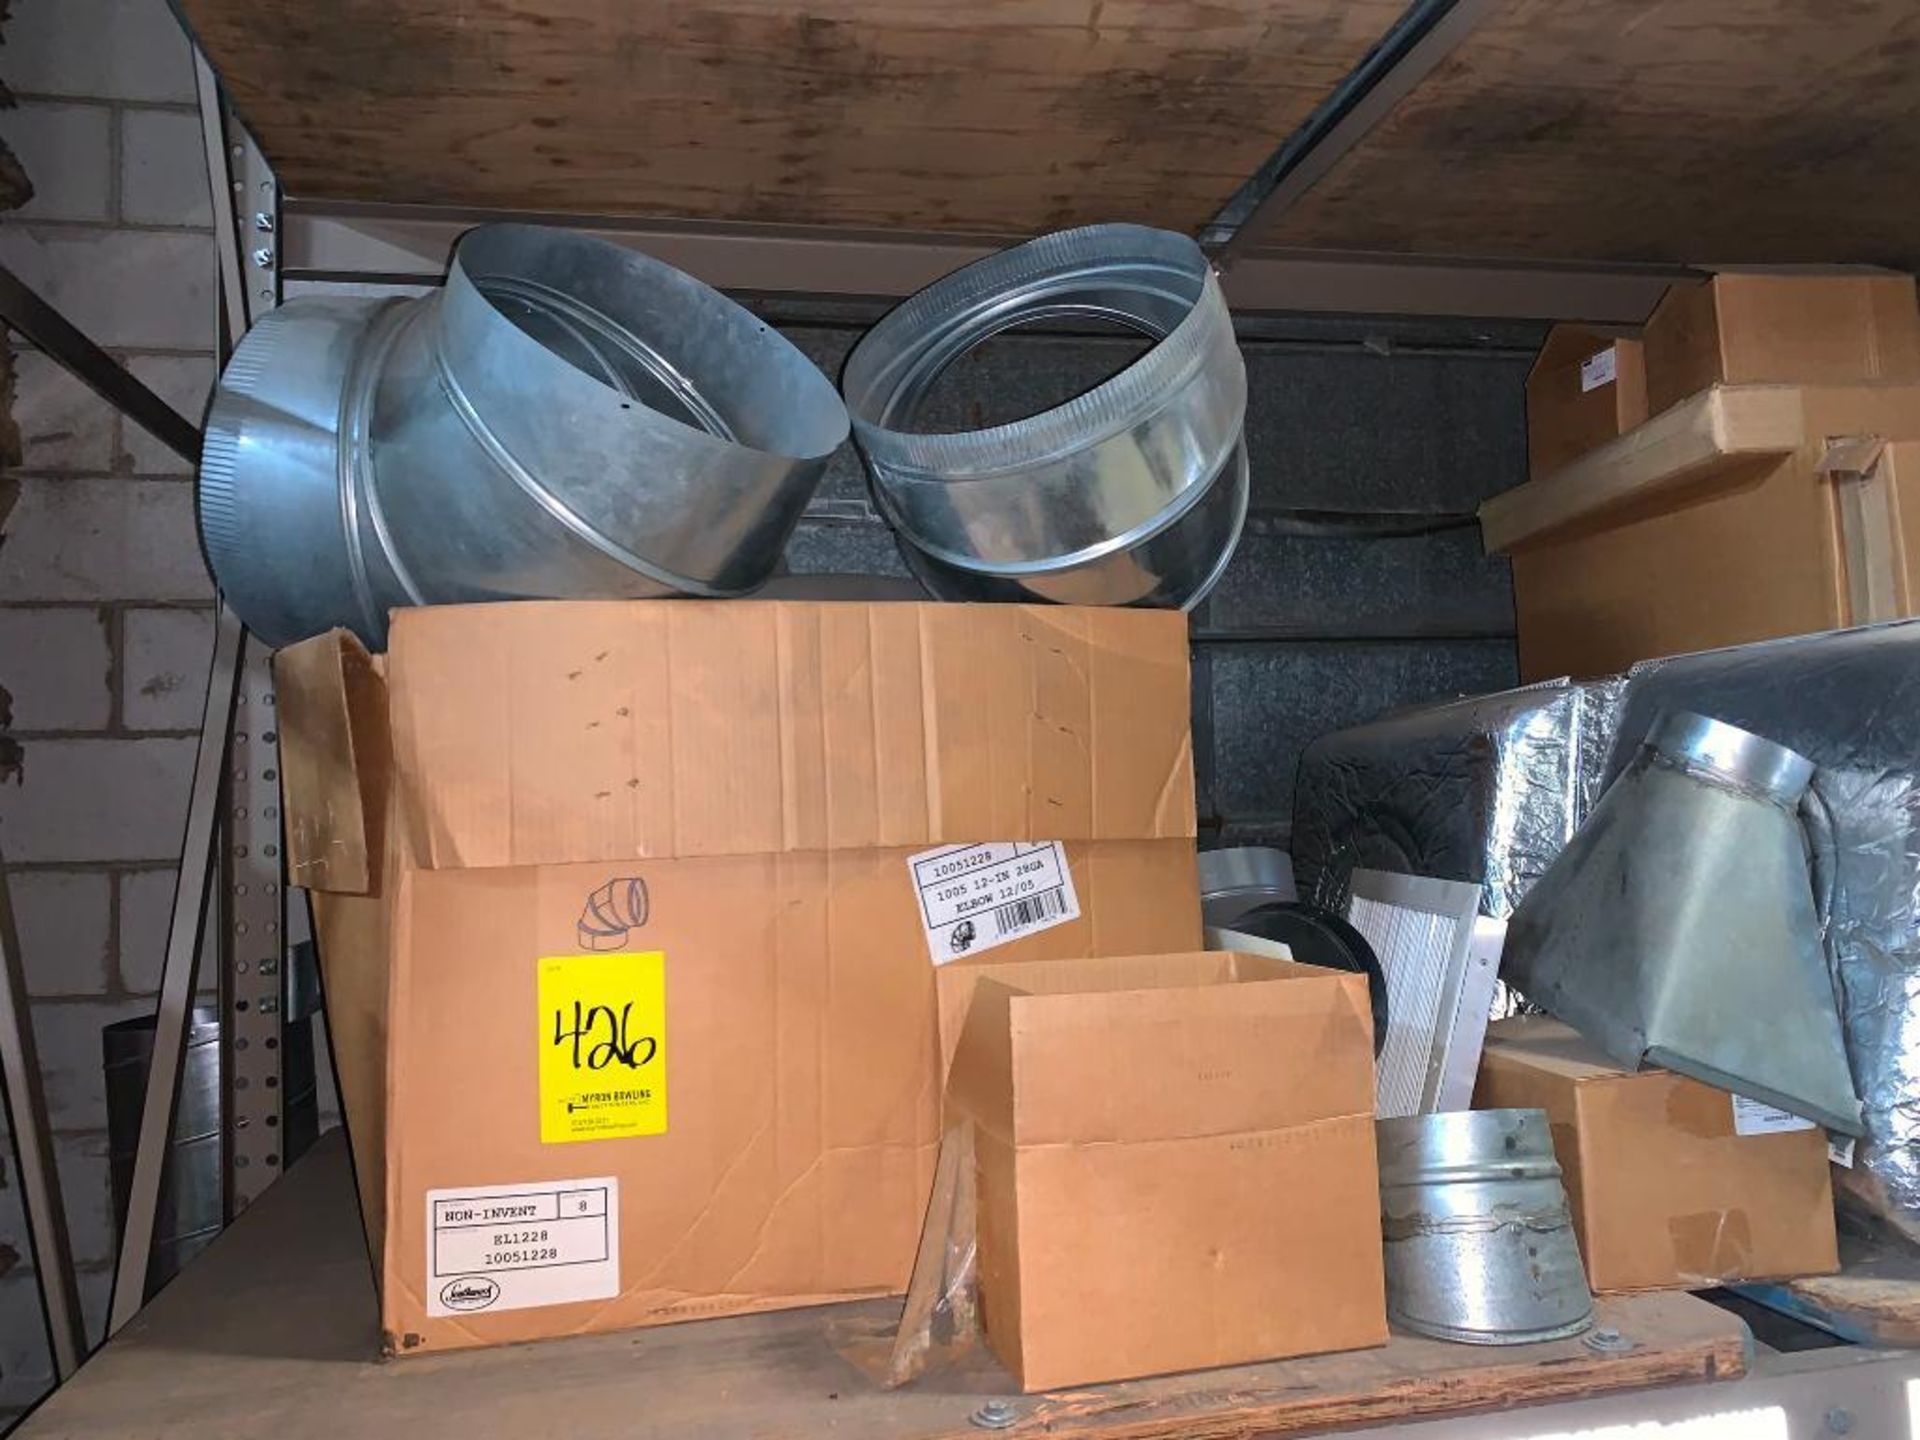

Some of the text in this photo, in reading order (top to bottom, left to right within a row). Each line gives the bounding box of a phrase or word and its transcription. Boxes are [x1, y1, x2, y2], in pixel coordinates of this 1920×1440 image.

[934, 852, 992, 877] 10051228
[937, 887, 968, 902] 1005
[974, 870, 1010, 890] 12-IN
[956, 880, 1035, 914] ELBOW 12/05
[554, 1001, 656, 1070] 426
[582, 1093, 611, 1103] MYRON
[614, 1089, 651, 1101] BOWLING
[445, 1205, 537, 1222] NON-INVENT
[578, 1201, 588, 1212] 8
[494, 1230, 548, 1246] EL1228
[485, 1248, 557, 1265] 10051228
